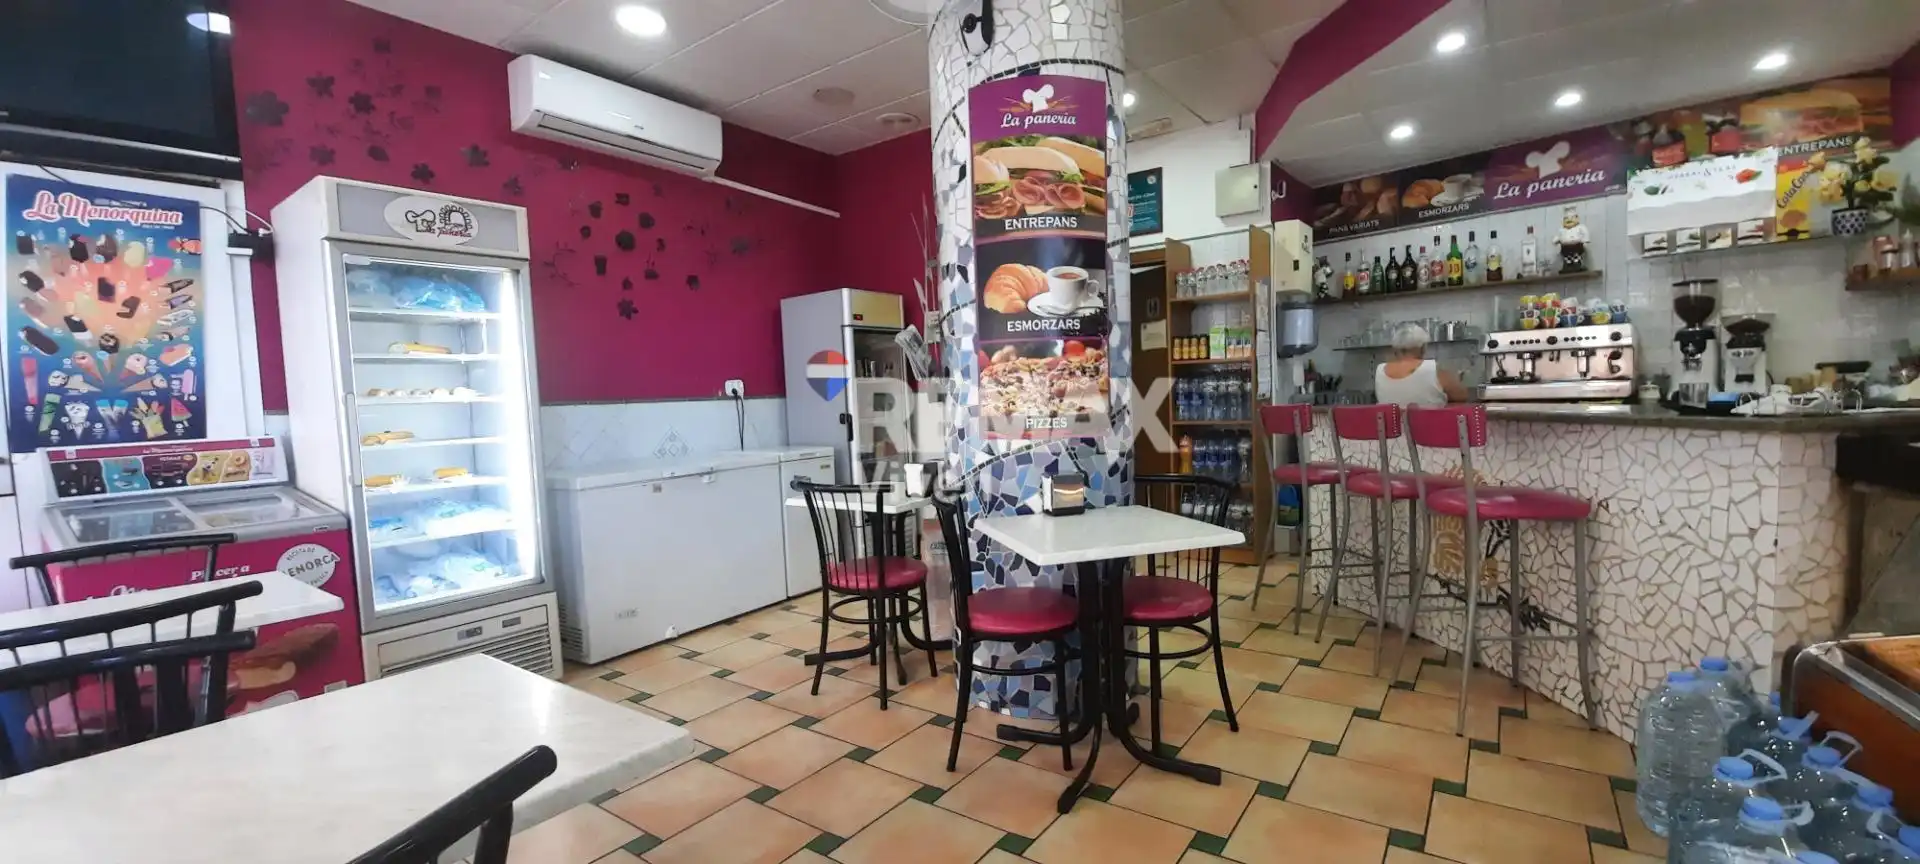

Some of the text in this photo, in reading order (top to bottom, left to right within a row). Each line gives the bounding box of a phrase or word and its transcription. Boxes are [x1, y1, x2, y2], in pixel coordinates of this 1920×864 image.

[1000, 112, 1076, 129] La paneria
[1494, 168, 1605, 200] La paneria
[23, 190, 183, 227] La Menorquina
[1418, 202, 1469, 218] ESMORZARS
[1005, 216, 1077, 231] ENTREPANS
[1350, 219, 1380, 232] VARIATS
[1007, 319, 1080, 332] ESMORZARS
[1026, 417, 1068, 429] PIZZES
[284, 554, 339, 577] ENORCA
